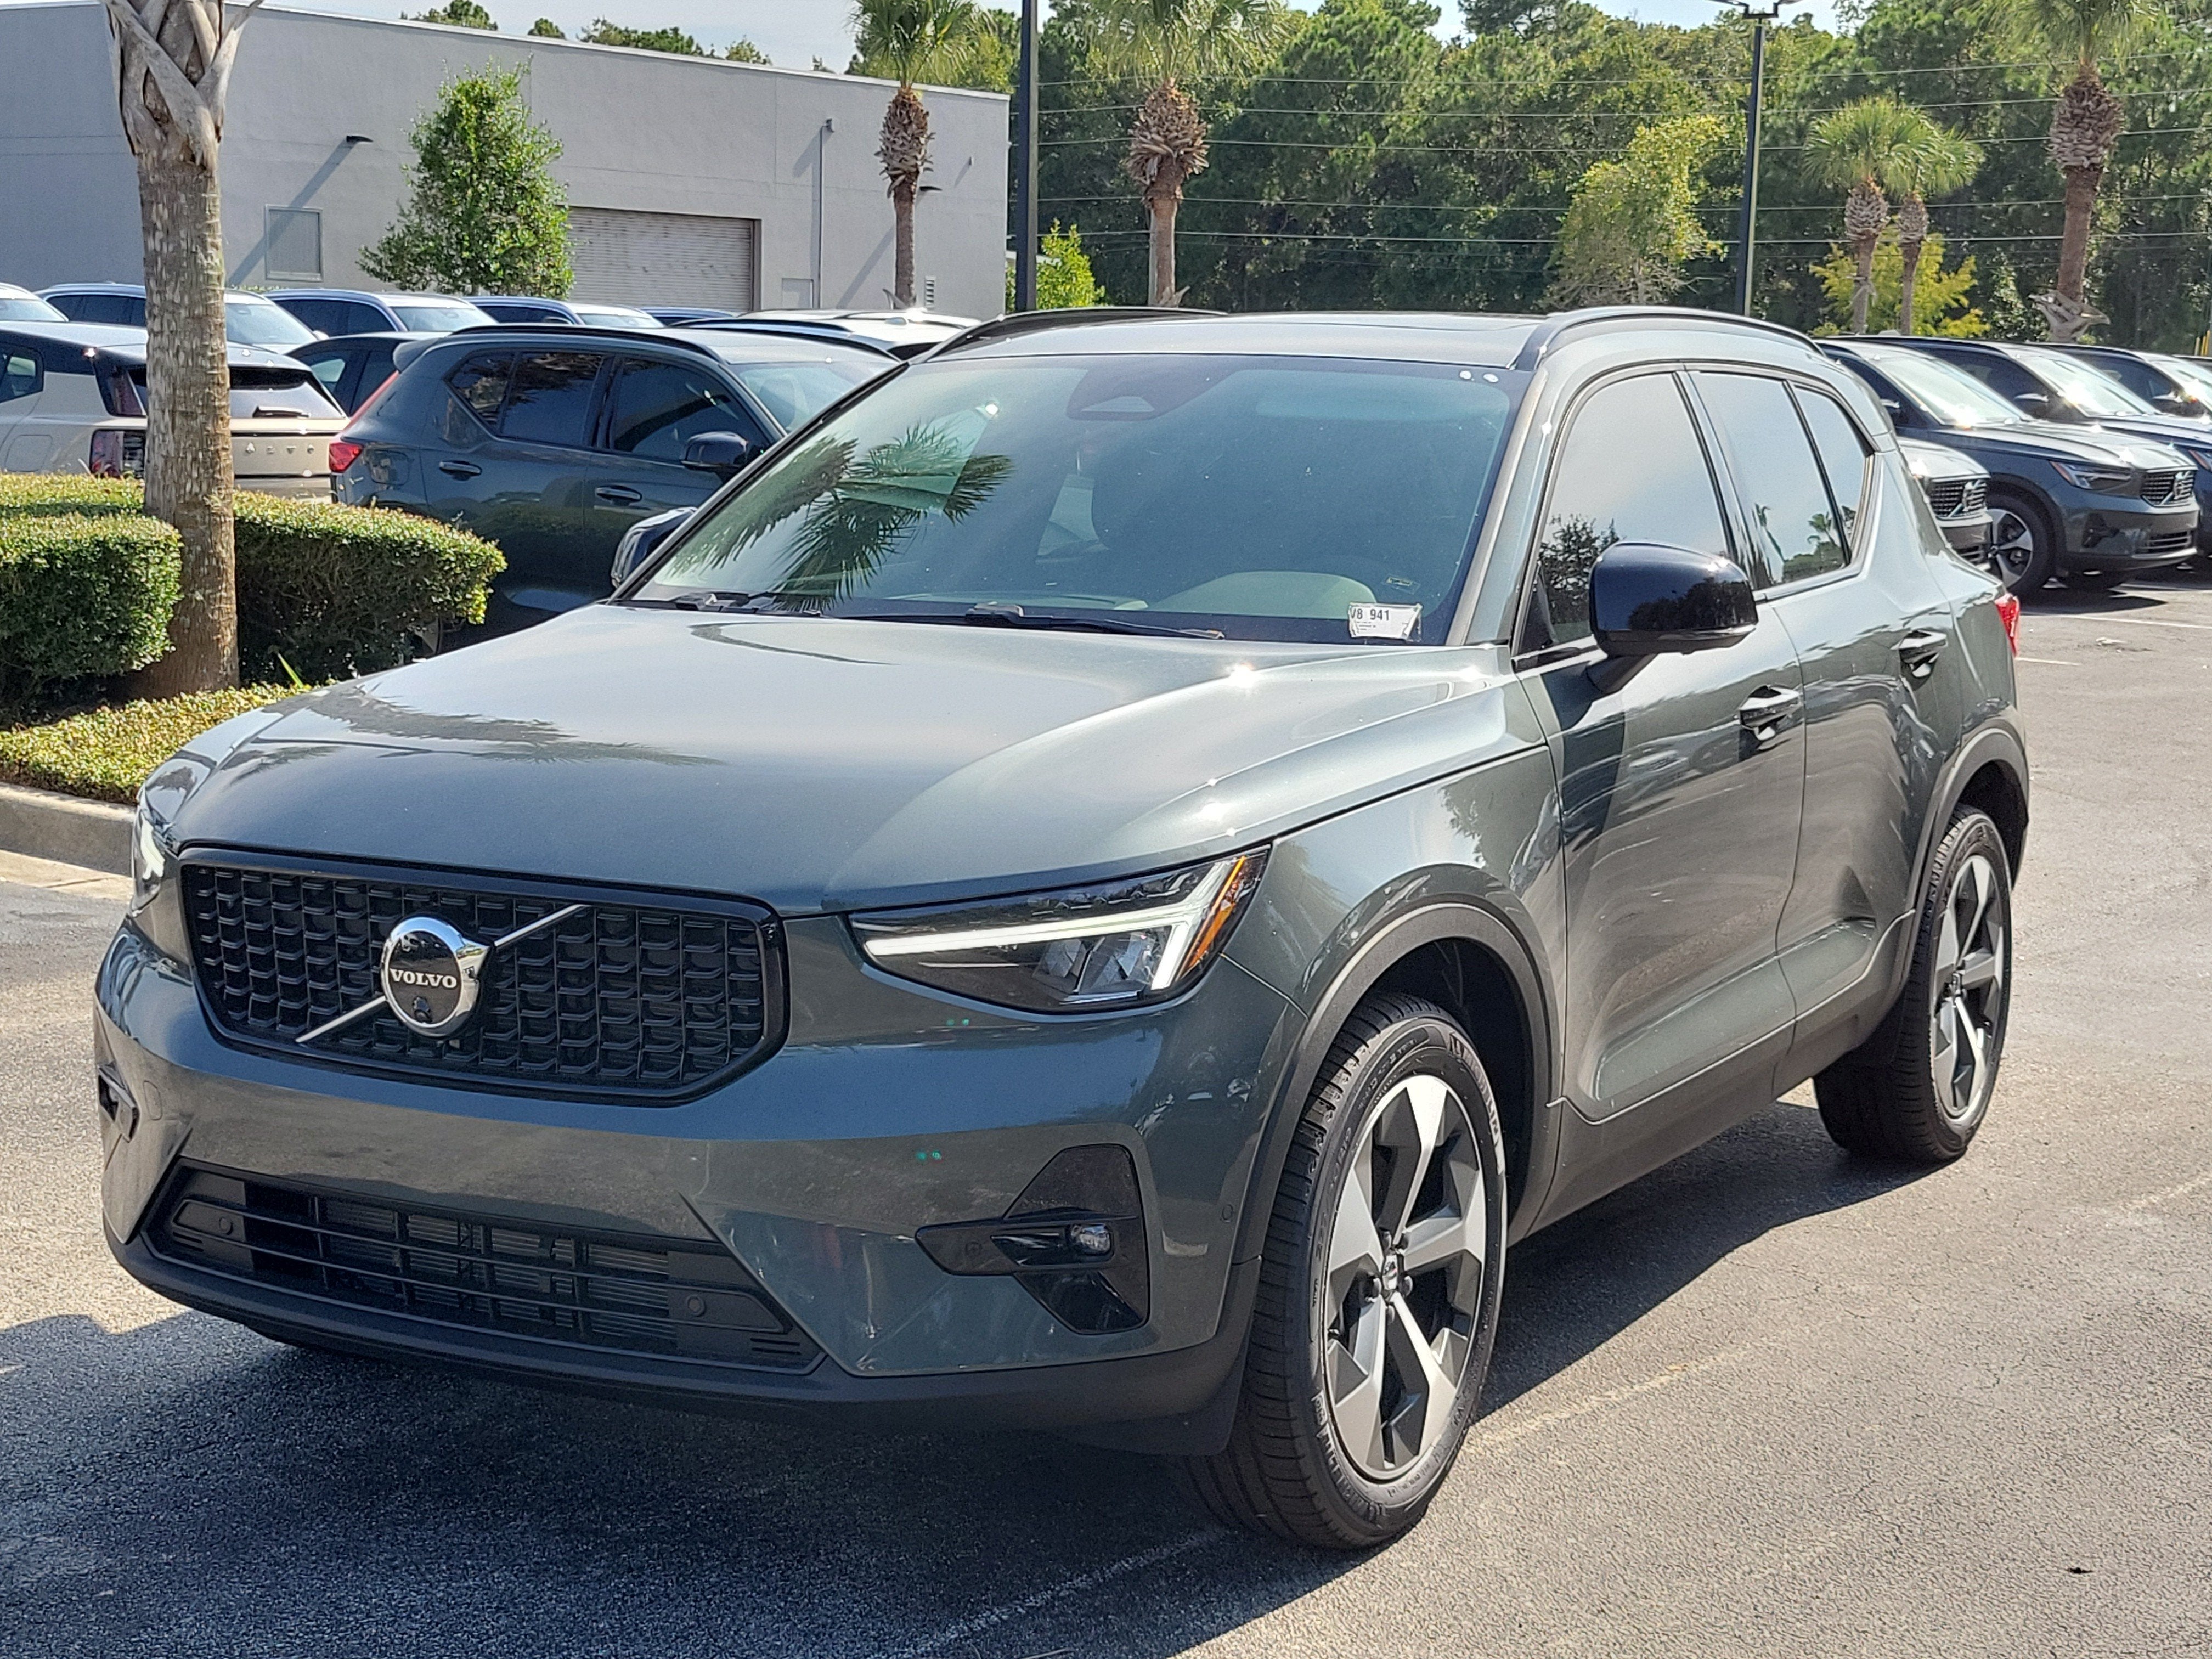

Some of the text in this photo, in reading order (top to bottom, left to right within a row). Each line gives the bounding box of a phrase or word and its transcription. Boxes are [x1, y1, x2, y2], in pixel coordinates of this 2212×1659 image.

[1350, 608, 1389, 621] V8 941
[390, 968, 457, 989] VOLVO
